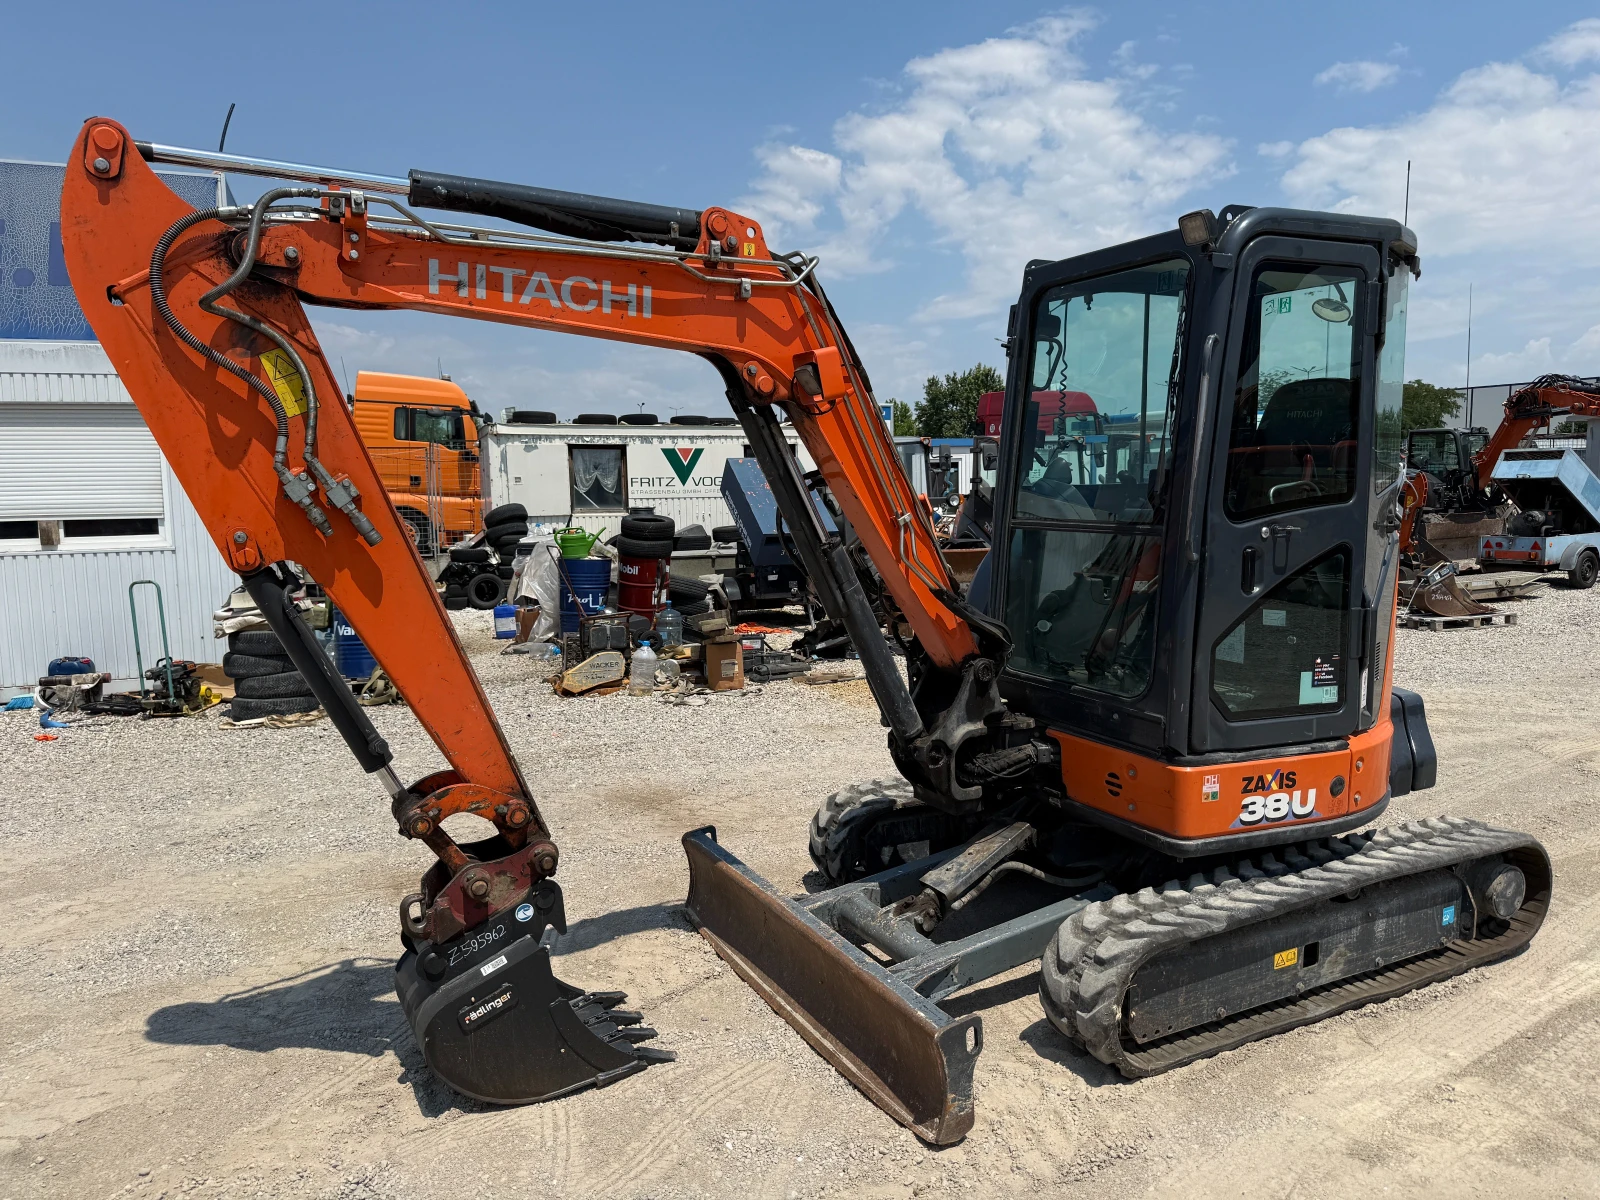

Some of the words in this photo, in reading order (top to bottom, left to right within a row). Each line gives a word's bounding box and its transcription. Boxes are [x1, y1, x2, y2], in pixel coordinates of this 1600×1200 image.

[428, 258, 652, 319] HITACHI
[630, 476, 676, 487] FRITZ
[589, 661, 620, 669] WACKER
[1241, 768, 1297, 794] ZAXIS
[1239, 789, 1317, 826] 38U
[447, 924, 507, 967] Z595962
[464, 991, 512, 1024] rädlinger
